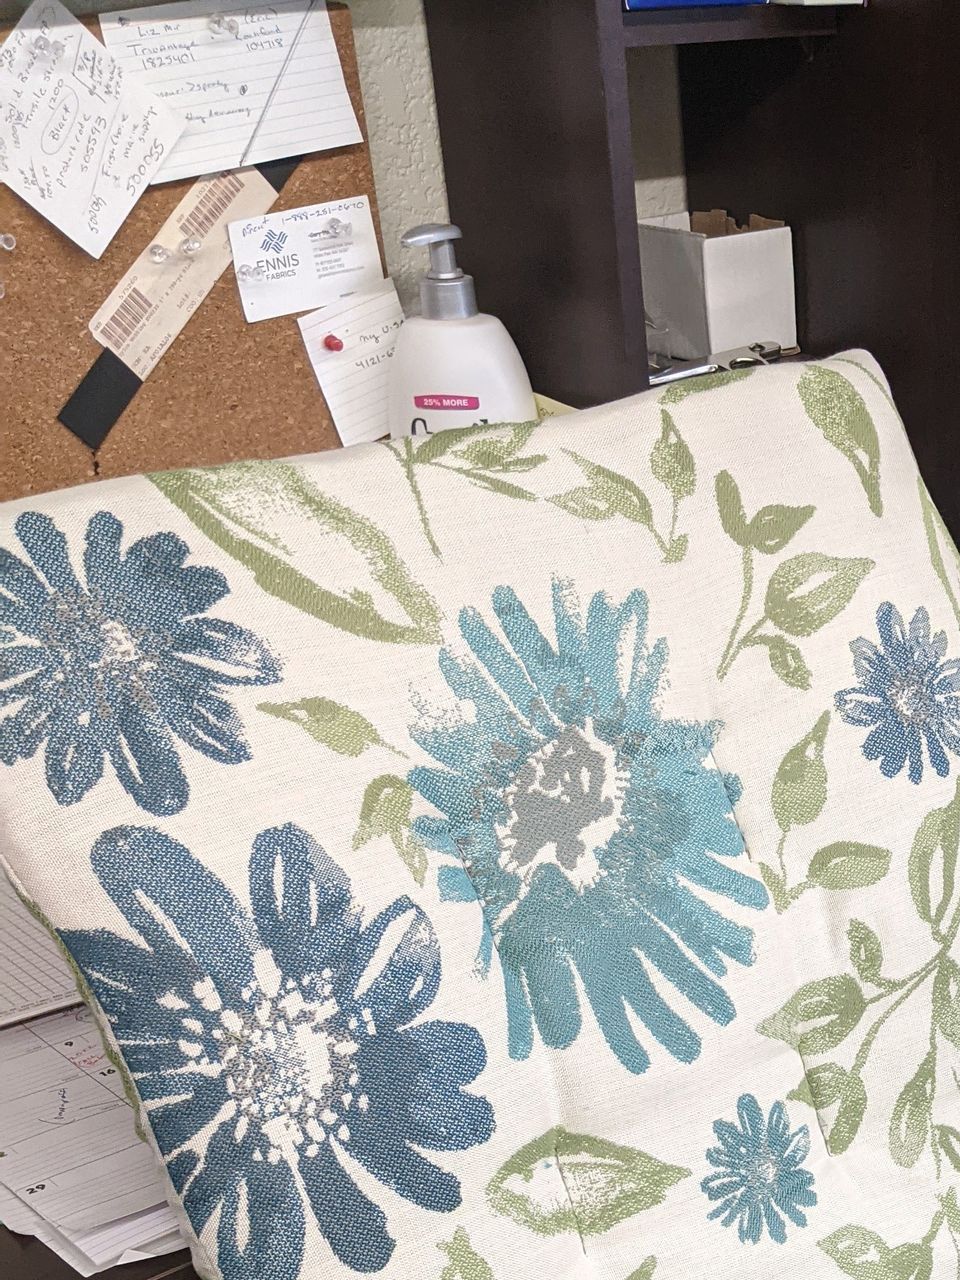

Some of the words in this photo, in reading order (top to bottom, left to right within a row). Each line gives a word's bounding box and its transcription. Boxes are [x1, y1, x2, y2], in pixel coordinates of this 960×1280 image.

[256, 253, 300, 272] ENNIS
[265, 269, 297, 280] FABRICS
[423, 398, 441, 406] 25%
[443, 398, 469, 407] MORE
[26, 1184, 46, 1195] 29
